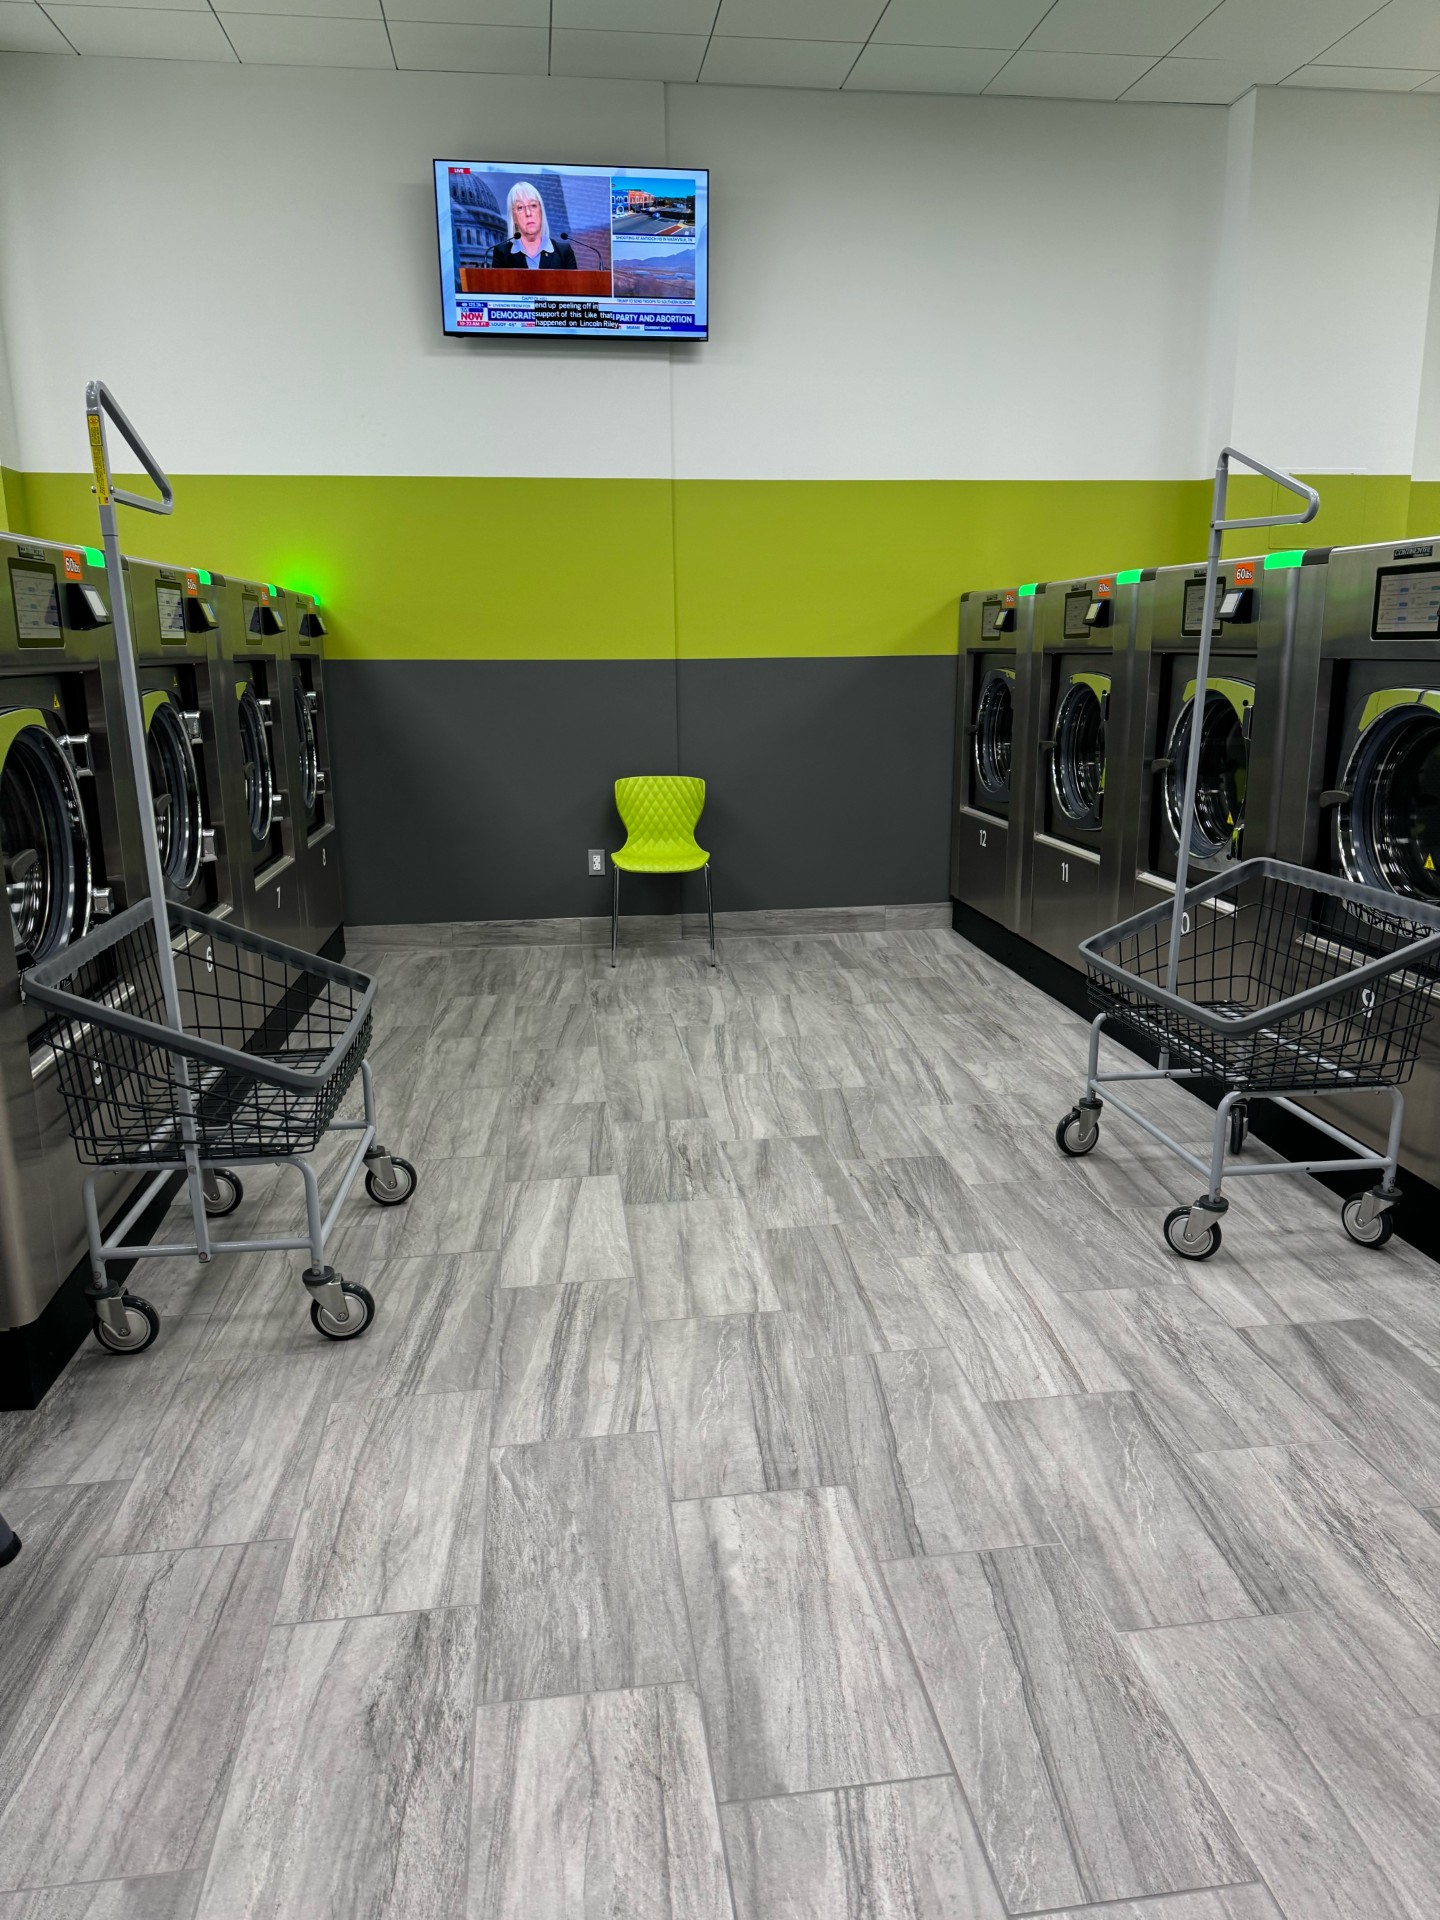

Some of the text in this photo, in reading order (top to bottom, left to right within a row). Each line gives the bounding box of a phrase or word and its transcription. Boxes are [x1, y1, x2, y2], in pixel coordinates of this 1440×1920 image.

[461, 312, 483, 320] NOW
[491, 310, 535, 320] DEMOCRATS
[656, 315, 692, 323] ABORTION
[1236, 568, 1252, 580] 60lbs
[980, 828, 987, 848] 12
[322, 848, 327, 866] 8
[1062, 862, 1068, 882] 11
[206, 946, 214, 972] 6
[1362, 988, 1376, 1018] 9
